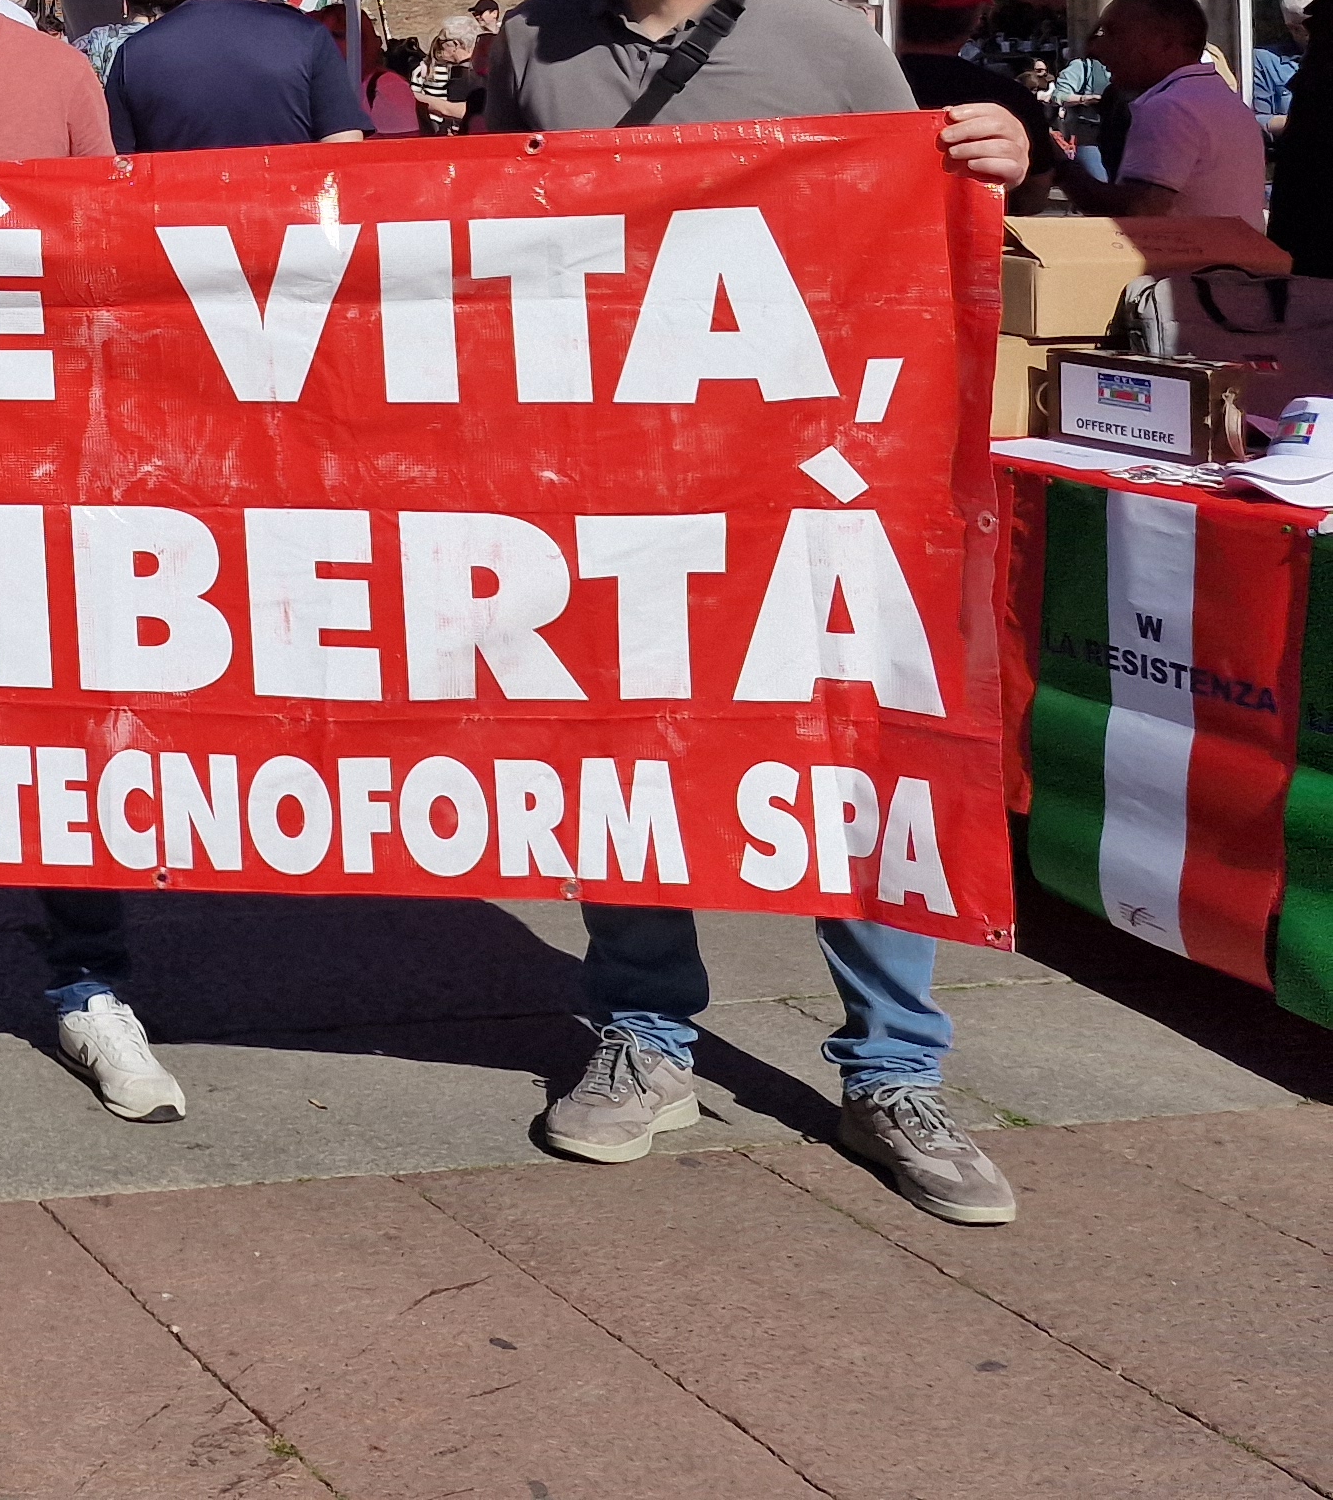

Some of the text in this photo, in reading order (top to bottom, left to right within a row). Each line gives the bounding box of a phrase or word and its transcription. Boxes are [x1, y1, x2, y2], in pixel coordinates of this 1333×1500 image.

[155, 206, 904, 424] VITA,
[1076, 417, 1175, 445] OFFERTE LIBERE
[1136, 612, 1163, 643] W
[1084, 636, 1279, 716] RESISTENZA
[737, 761, 958, 917] SPA
